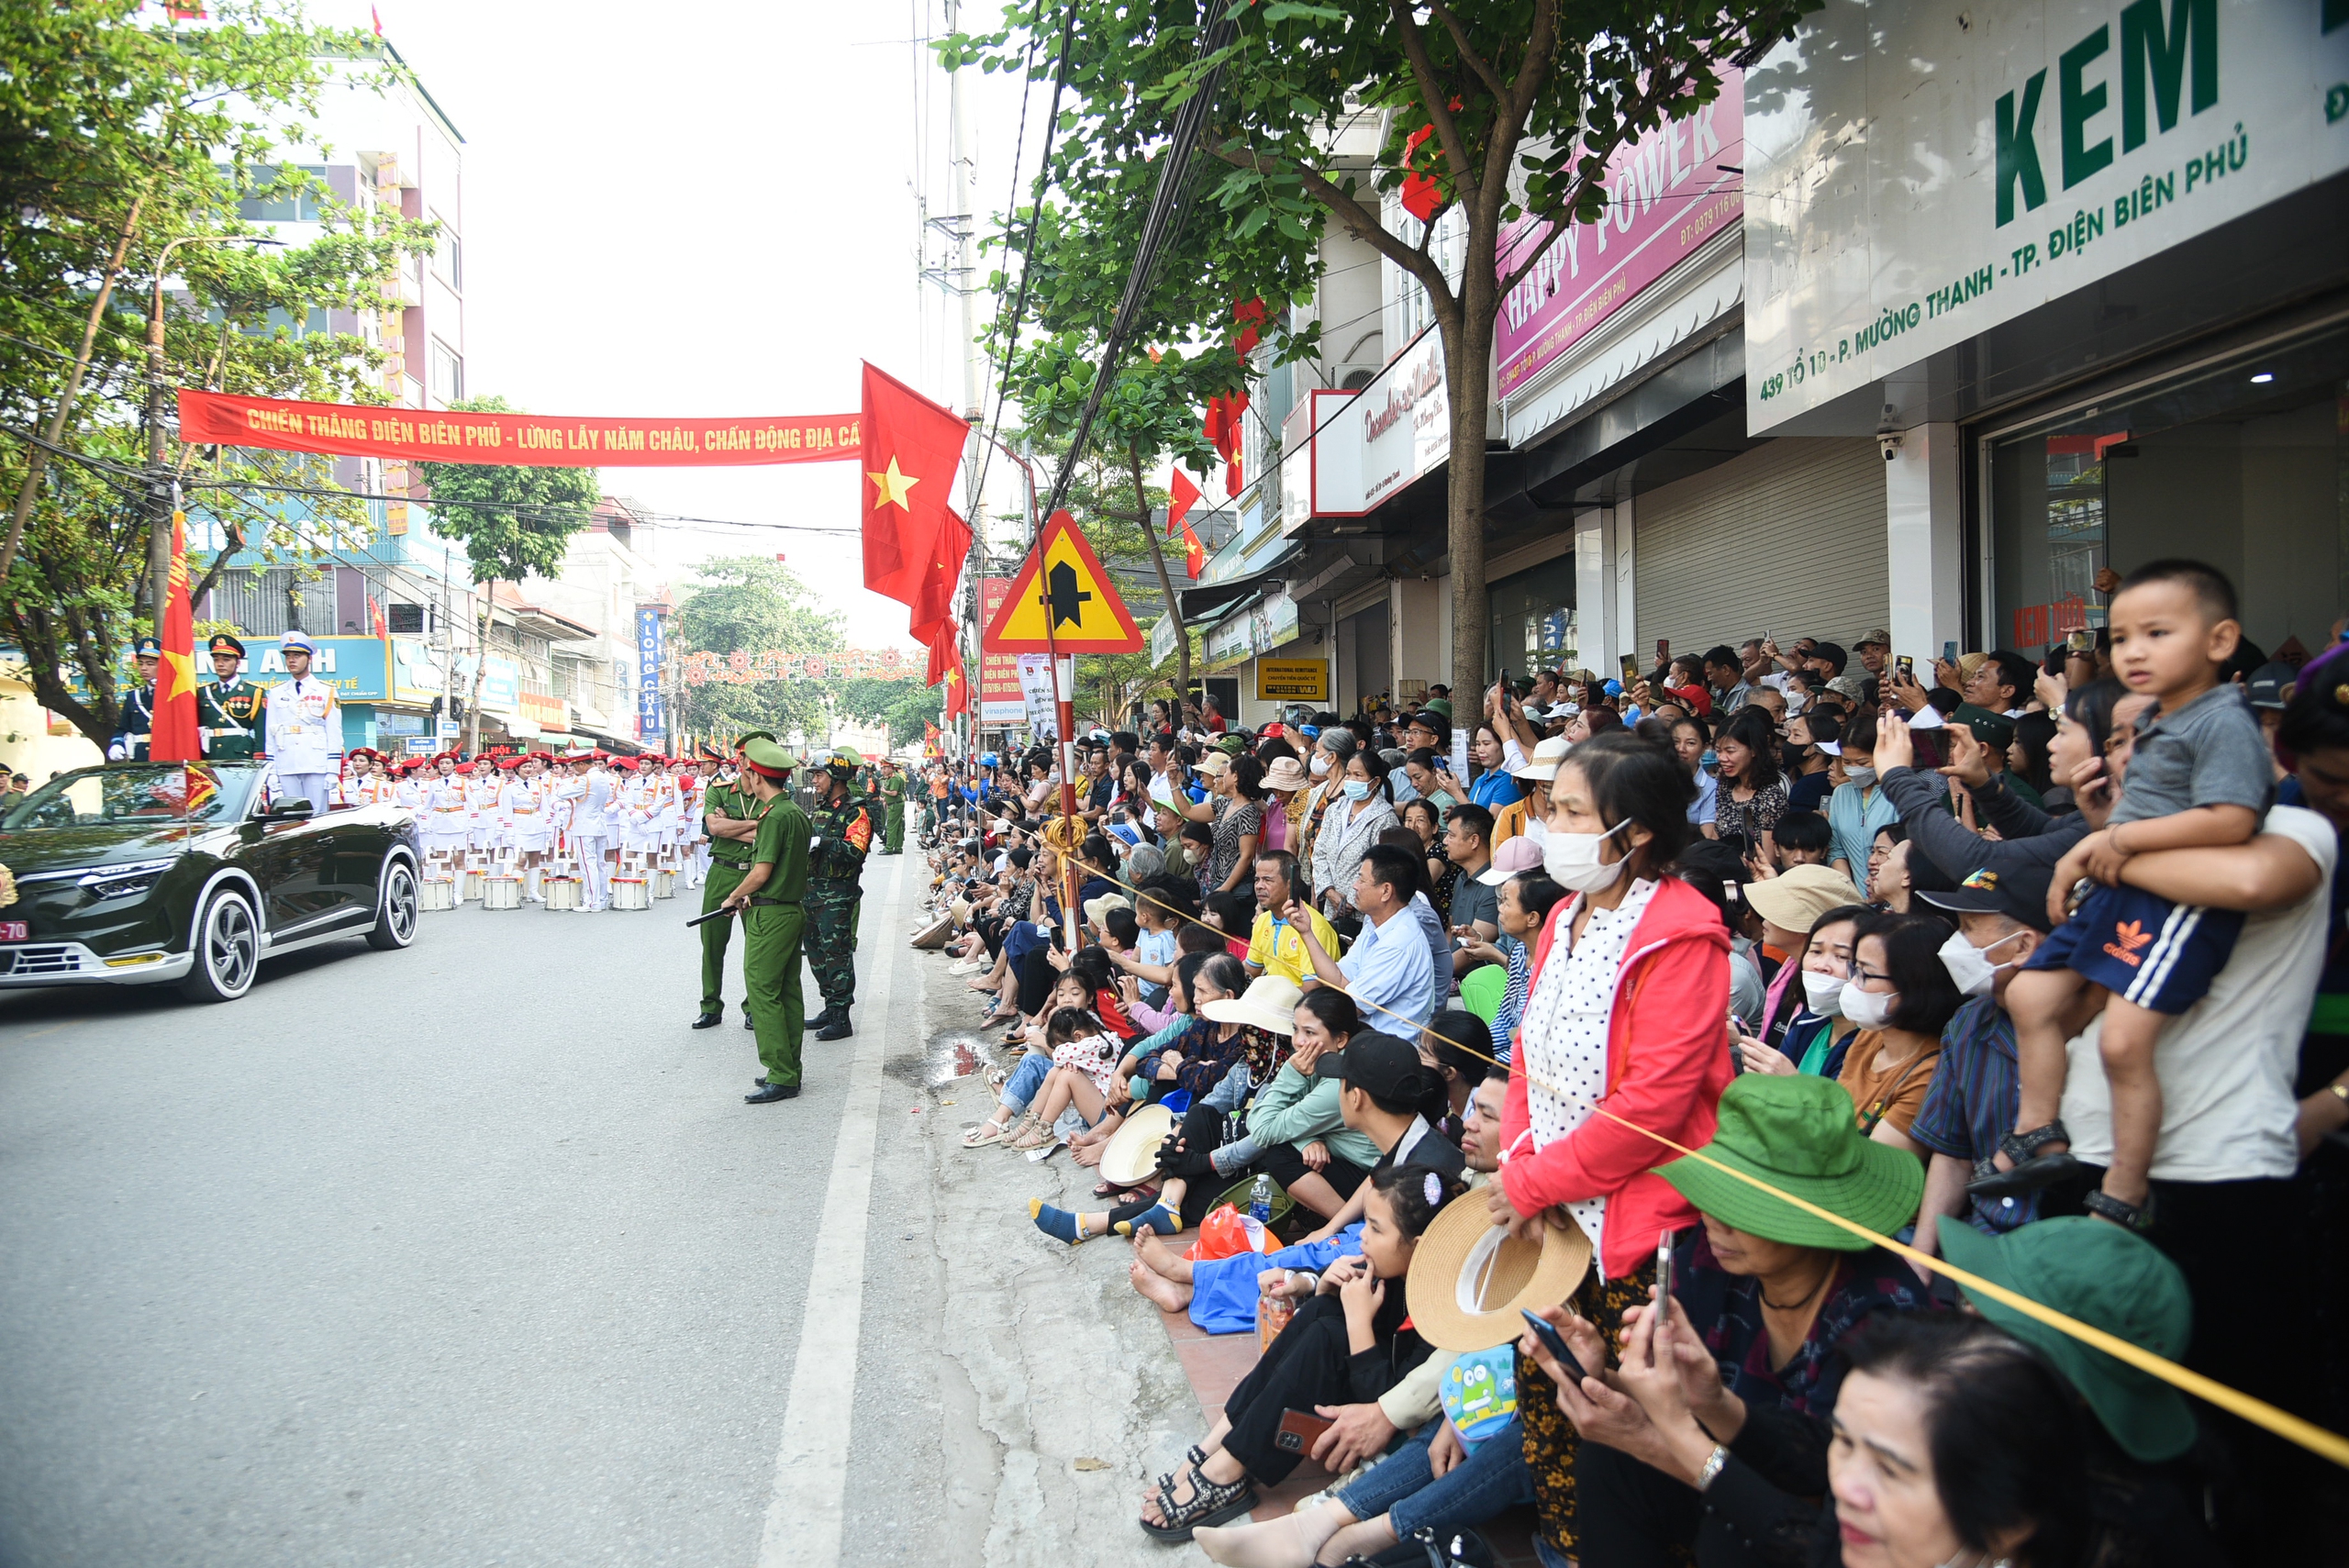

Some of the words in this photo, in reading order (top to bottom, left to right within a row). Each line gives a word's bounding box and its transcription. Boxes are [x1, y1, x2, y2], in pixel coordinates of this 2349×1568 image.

[1995, 0, 2219, 229] KEM
[1508, 218, 1579, 336] HAPPY
[1598, 101, 1720, 255] POWER
[1695, 207, 1713, 235] 0379
[1715, 195, 1729, 219] 116
[1760, 373, 1784, 402] 439
[1839, 339, 1852, 364] P.
[1855, 303, 1920, 356] MƯỜNG
[1926, 264, 1992, 320] THANH
[2011, 242, 2040, 278] TP.
[2047, 206, 2104, 261] ĐIỆN
[2114, 171, 2175, 229] BIÊN
[2185, 120, 2247, 195] PHỦ
[1554, 321, 1573, 345] THANH
[1598, 287, 1612, 311] BIÊN
[1612, 271, 1626, 300] PHỦ
[246, 406, 304, 435] CHIẾN
[306, 412, 367, 440] THẮNG
[372, 417, 414, 446] ĐIỆN
[419, 419, 461, 446] BIÊN
[465, 421, 501, 448] PHỦ
[517, 423, 562, 450] LỪNG
[567, 424, 599, 450] LẪY
[604, 427, 645, 450] NĂM
[648, 427, 700, 454] CHÂU,
[704, 424, 751, 450] CHẤN
[753, 424, 801, 453] ĐỘNG
[805, 427, 834, 451] ĐỊA
[837, 419, 861, 447] CẦ
[643, 625, 656, 674] LONG
[2013, 603, 2049, 650] KEM
[260, 648, 337, 673] AH
[984, 668, 996, 681] ĐIỆN
[997, 668, 1009, 680] BIÊN
[1002, 653, 1017, 666] THẮN
[985, 706, 1023, 716] vinaphone
[2103, 942, 2142, 967] adidas
